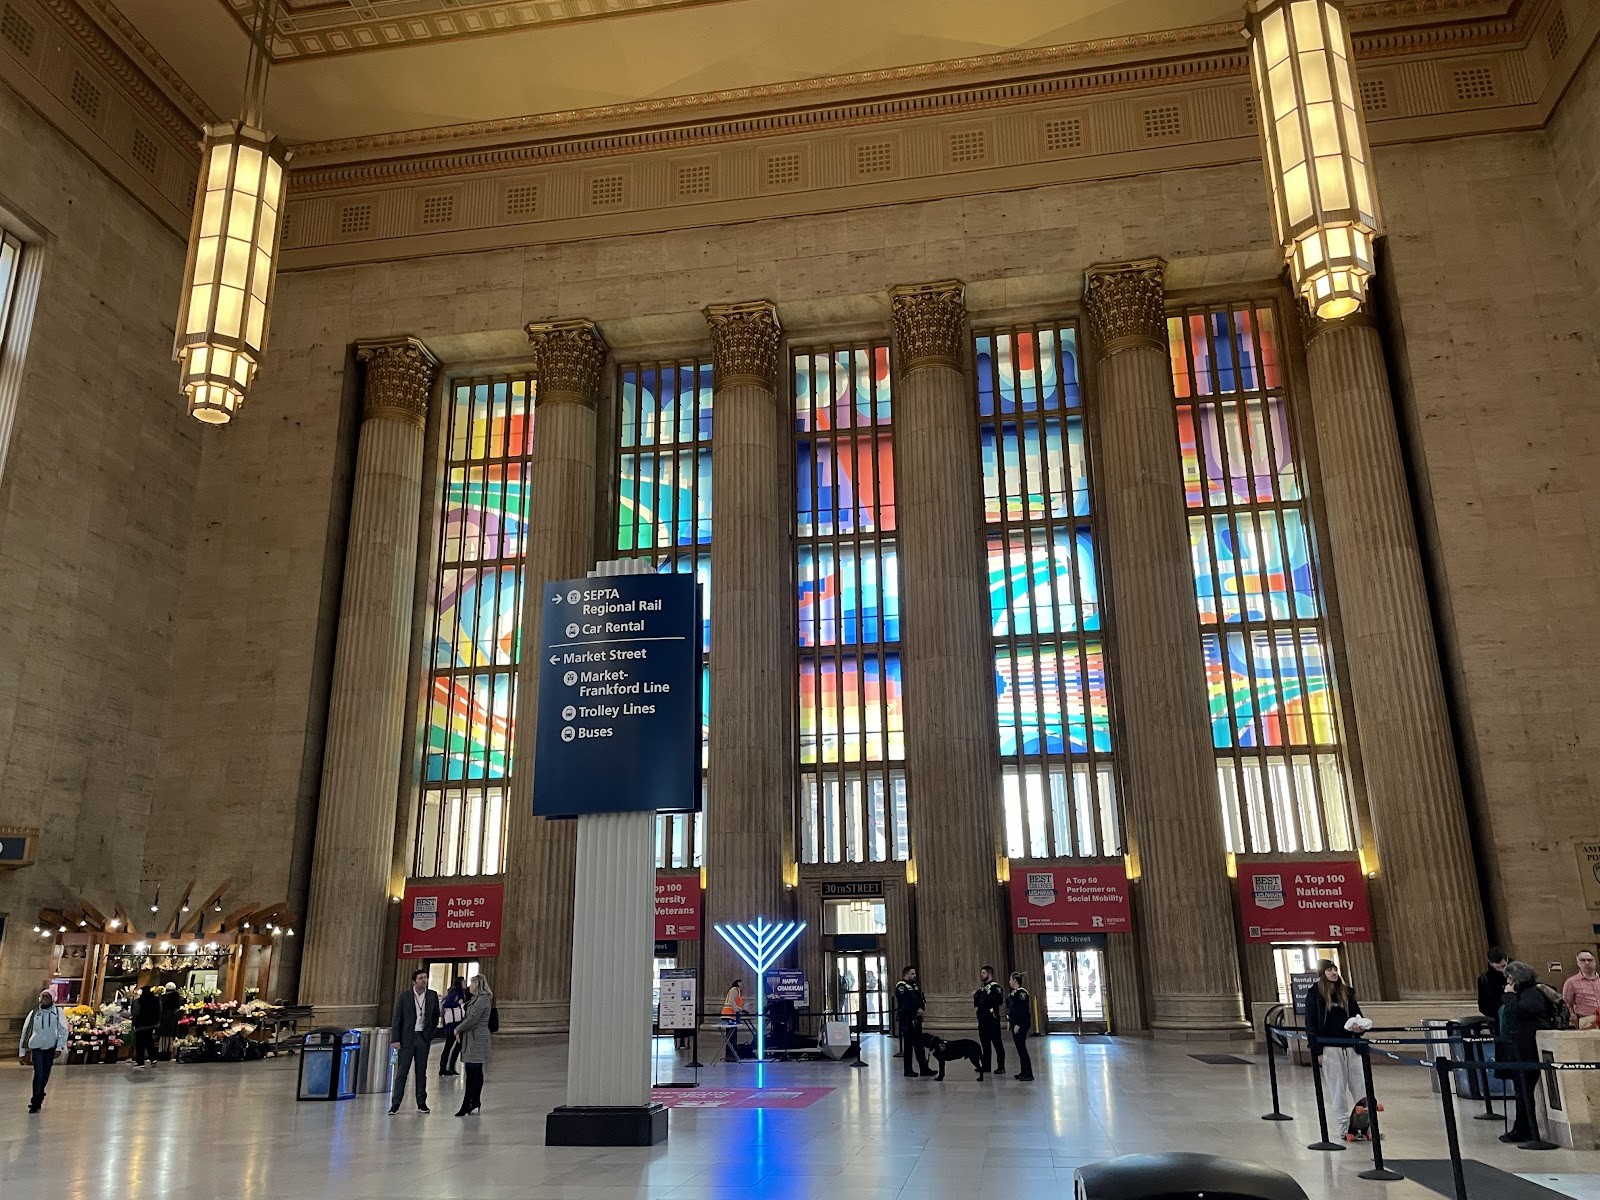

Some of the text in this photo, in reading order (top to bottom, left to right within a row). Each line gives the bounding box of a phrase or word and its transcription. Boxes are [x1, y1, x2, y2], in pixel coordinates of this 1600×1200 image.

[583, 588, 620, 602] SEPTA
[583, 600, 662, 616] Regional Rail
[582, 620, 645, 634] Car Rental
[563, 648, 647, 664] Market Street
[580, 670, 628, 682] Market-
[580, 682, 670, 696] Frankford Line
[578, 702, 656, 718] Trolley Lines
[578, 727, 613, 738] Buses
[1074, 877, 1087, 885] Top
[1256, 876, 1279, 885] BEST
[1295, 875, 1345, 885] A Top 100
[667, 884, 682, 892] 100
[846, 884, 880, 893] STREET
[1296, 887, 1342, 896] National
[448, 898, 454, 906] A
[456, 898, 472, 907] Top
[654, 895, 686, 904] versity
[1092, 895, 1123, 903] Mobility
[1298, 899, 1354, 910] University
[447, 909, 475, 917] Public
[446, 920, 491, 929] University
[1092, 916, 1104, 927] R
[666, 925, 676, 935] R
[1329, 925, 1342, 936] R
[467, 942, 477, 952] R
